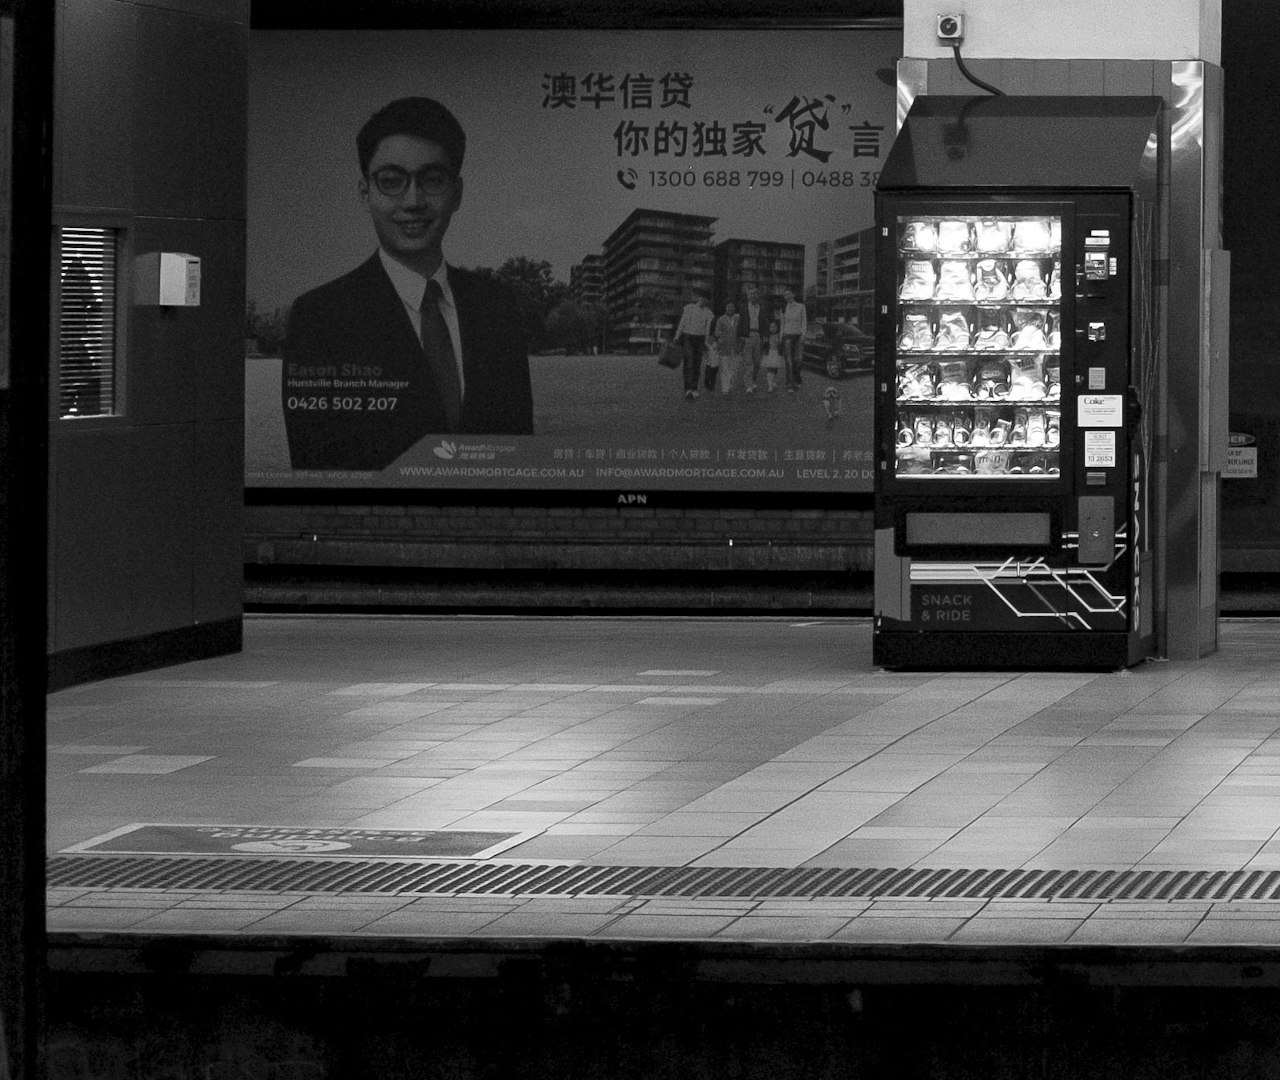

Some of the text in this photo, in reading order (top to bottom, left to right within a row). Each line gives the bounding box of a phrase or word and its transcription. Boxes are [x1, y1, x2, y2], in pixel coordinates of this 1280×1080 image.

[541, 72, 694, 109] 澳华信贷
[649, 170, 697, 188] 1300
[702, 170, 742, 188] 688
[746, 170, 785, 188] 799
[801, 170, 854, 188] 0488
[288, 362, 383, 377] Eason Shao
[287, 378, 410, 390] Hurstville Branch Manager
[287, 396, 398, 411] 0426 502 207
[399, 466, 585, 478] WWW.AWARDMORTGAGE.COM.AU
[796, 468, 830, 479] LEVEL
[844, 469, 859, 479] 20
[617, 493, 647, 504] APN
[921, 594, 973, 606] SNACK
[921, 610, 971, 622] & RIDE
